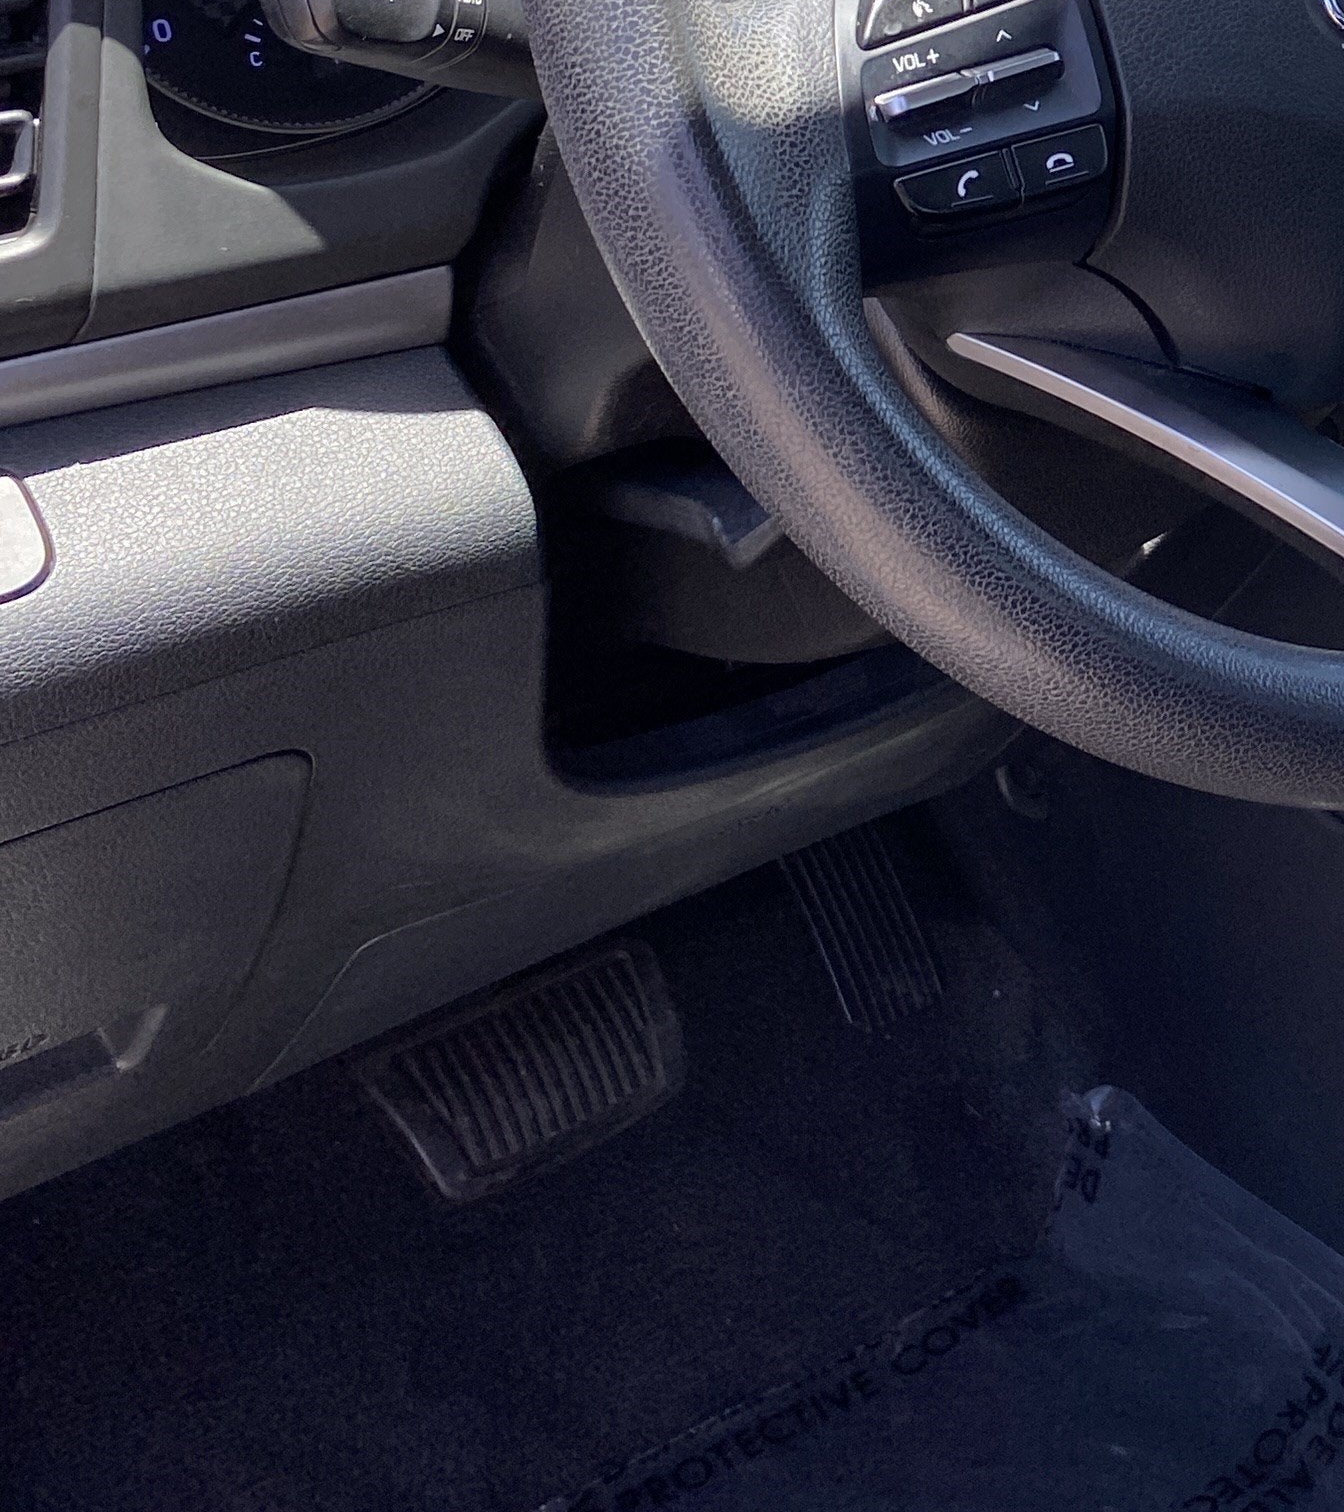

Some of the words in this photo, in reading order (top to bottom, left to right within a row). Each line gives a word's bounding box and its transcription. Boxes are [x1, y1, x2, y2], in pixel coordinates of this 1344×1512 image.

[153, 19, 173, 43] 0
[454, 28, 475, 42] OFF
[250, 51, 264, 68] C
